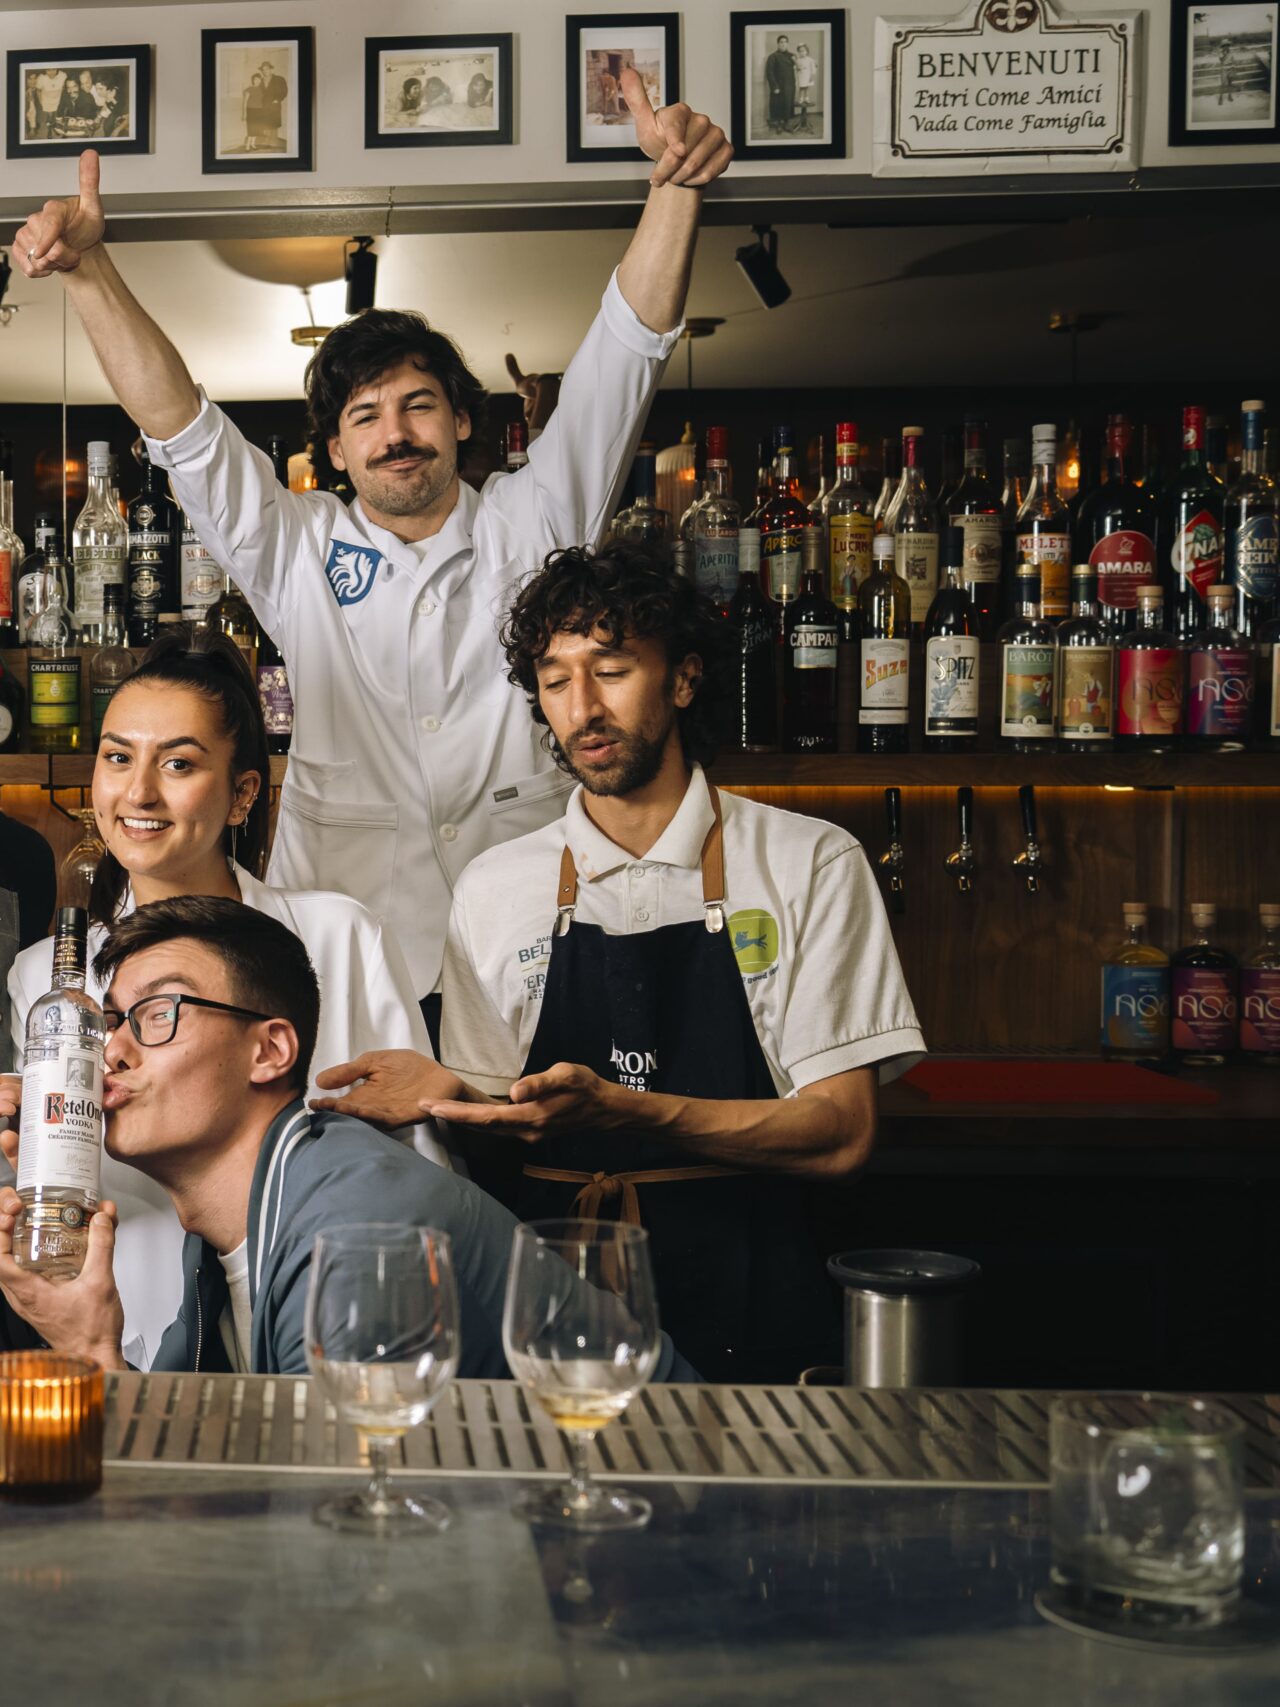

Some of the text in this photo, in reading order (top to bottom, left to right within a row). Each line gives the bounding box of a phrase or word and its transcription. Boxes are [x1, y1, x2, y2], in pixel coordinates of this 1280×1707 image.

[916, 48, 1101, 79] BENVENUTI
[914, 83, 1103, 110] Entri Come Amici
[909, 111, 1106, 137] Vada Come Famiglia
[1097, 561, 1153, 575] AMARA
[30, 663, 80, 672] CHARTREUSE
[934, 656, 976, 681] SPITZ
[46, 1094, 85, 1122] Ketel
[65, 1117, 94, 1130] VODKA
